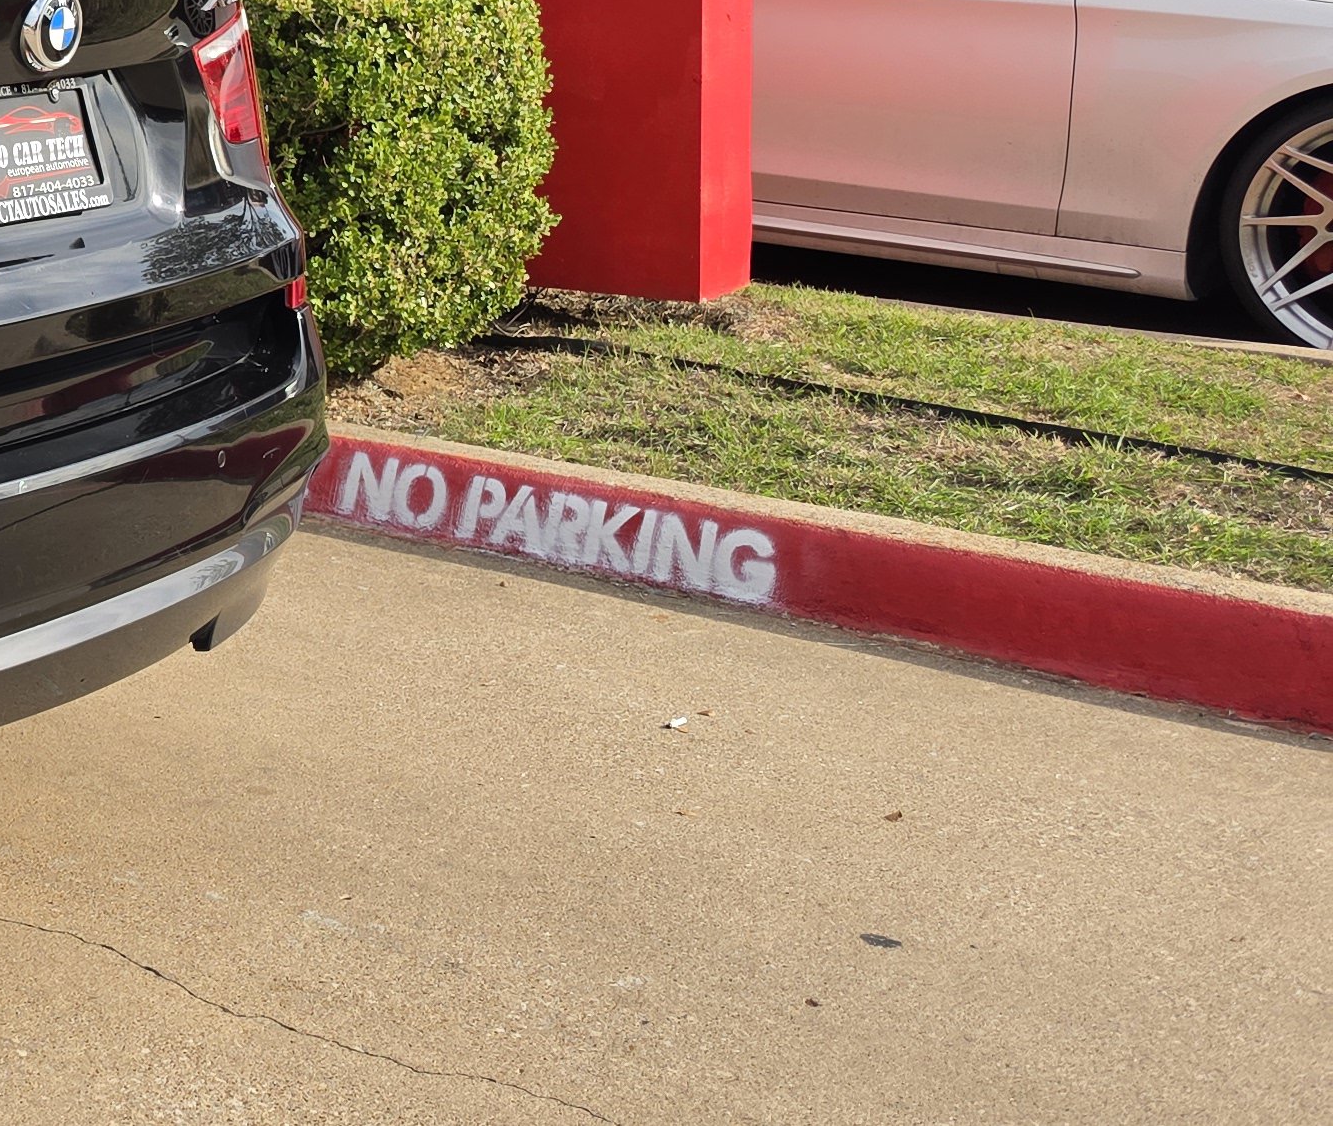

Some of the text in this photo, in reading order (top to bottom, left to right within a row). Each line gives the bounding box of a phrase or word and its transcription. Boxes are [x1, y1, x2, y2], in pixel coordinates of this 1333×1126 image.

[12, 140, 45, 166] CAR
[46, 134, 86, 161] TECH
[7, 157, 90, 177] european automotive
[12, 175, 95, 198] 817-404-4033
[338, 451, 777, 605] NO PARKING
